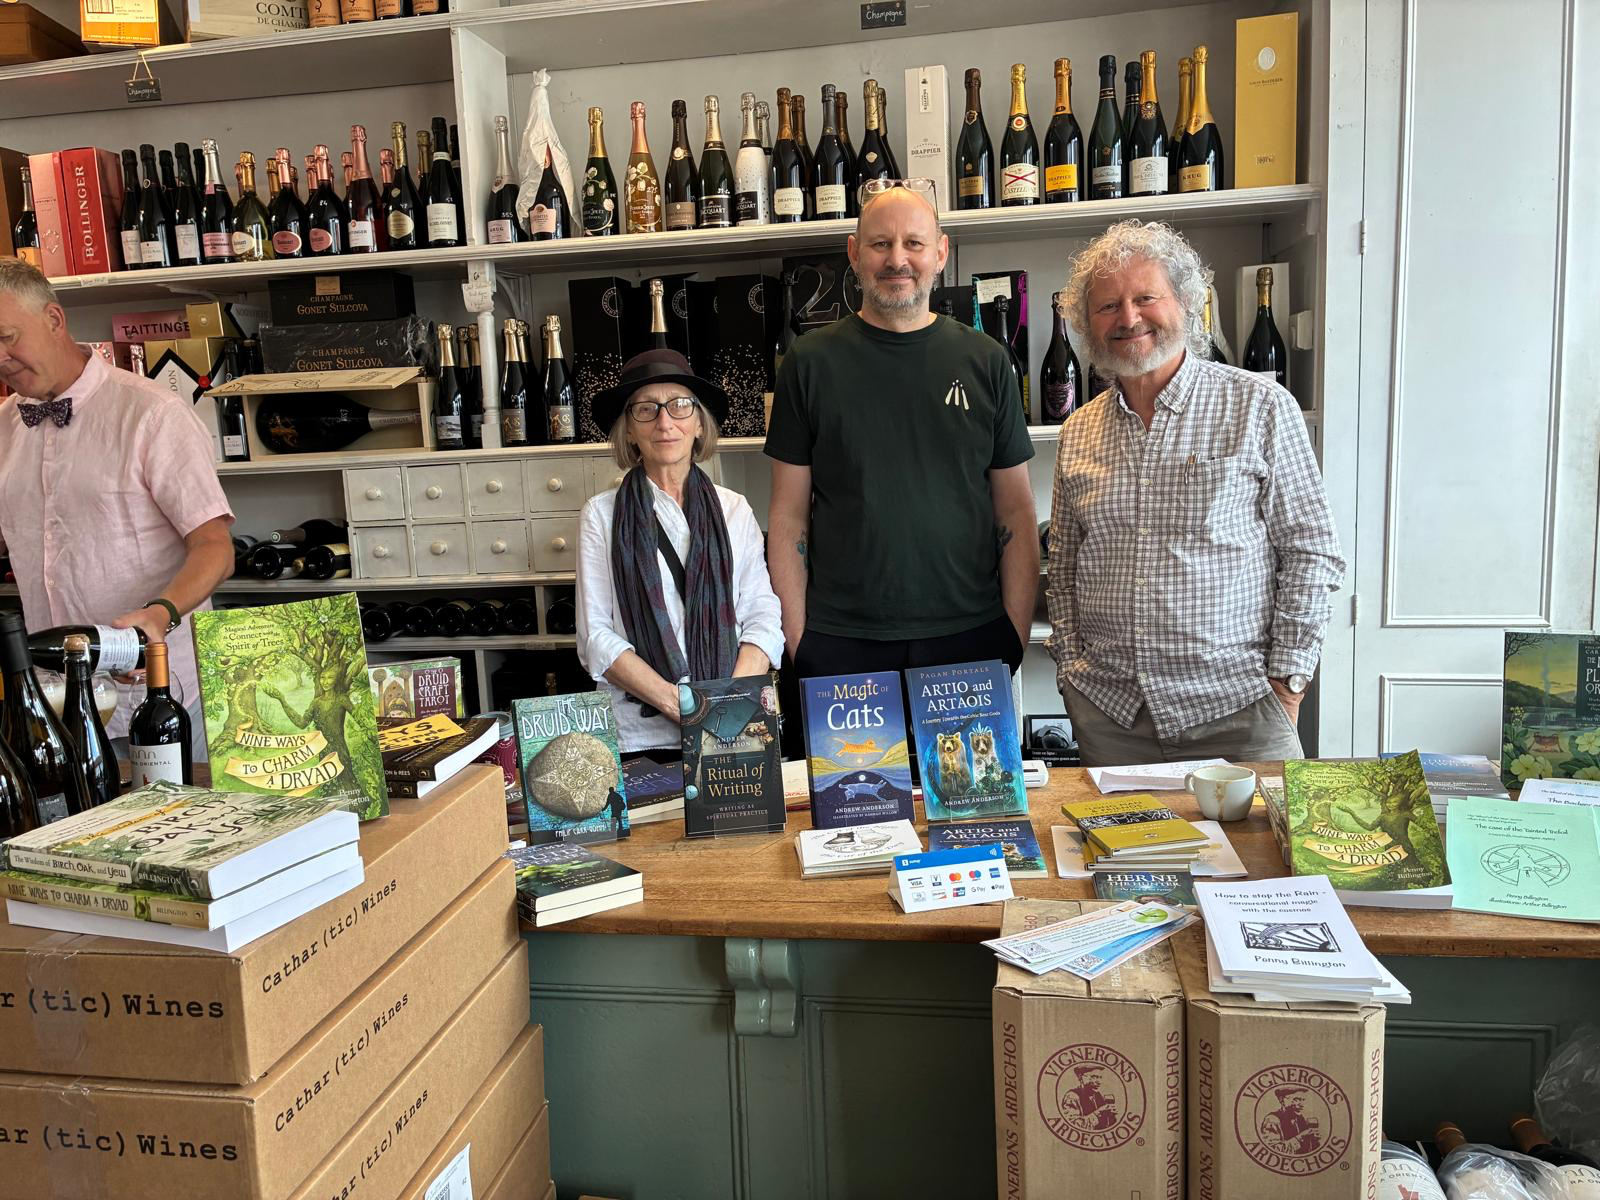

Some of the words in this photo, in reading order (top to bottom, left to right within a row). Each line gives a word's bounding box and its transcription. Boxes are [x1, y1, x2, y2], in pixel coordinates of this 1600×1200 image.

[257, 17, 270, 26] DE
[866, 9, 904, 22] Champagne
[127, 87, 158, 99] Champagne
[911, 147, 941, 156] DRAPPIER
[75, 166, 95, 258] BOLLINGER
[310, 294, 354, 303] CHAMPAGNE
[297, 304, 327, 315] GONET
[329, 303, 369, 313] SULCOVA
[122, 321, 190, 335] TAITTINGE
[312, 346, 365, 357] CHAMPAGNE
[297, 359, 332, 372] GONET
[336, 357, 384, 370] SULCOVA
[229, 632, 262, 641] Connect
[226, 641, 250, 653] Spirit
[252, 642, 259, 651] of
[260, 637, 284, 648] Trees
[920, 671, 948, 679] PAGAN
[951, 666, 990, 676] PORTALS
[418, 673, 449, 687] DRUID
[418, 684, 449, 698] CRAFT
[816, 690, 832, 698] THE
[833, 682, 879, 701] Magic
[921, 681, 968, 698] ARTIO
[972, 680, 993, 692] and
[419, 695, 450, 708] TAROT
[927, 694, 992, 712] ARTAOIS
[521, 712, 571, 740] DRUID
[575, 705, 610, 732] WAY
[827, 703, 884, 731] Cats
[240, 732, 272, 747] NINE
[275, 735, 306, 747] WAYS
[713, 741, 752, 750] ANDERSON
[716, 735, 746, 743] ANDREW
[262, 745, 314, 774] CHARM
[714, 756, 732, 765] THE
[280, 761, 338, 789] DRYAD
[707, 763, 748, 781] Ritual
[751, 761, 765, 779] of
[338, 787, 361, 796] Penny
[708, 781, 763, 797] Writing
[944, 798, 970, 806] ANDREW
[971, 795, 1005, 803] ANDERSON
[706, 812, 738, 820] SPIRITUAL
[739, 809, 769, 817] PRACTICE
[719, 804, 746, 812] WRITING
[835, 806, 861, 814] ANDREW
[862, 803, 895, 811] ANDERSON
[941, 827, 993, 835] ARTIO
[947, 831, 1018, 840] ARTAOIS
[1316, 827, 1345, 838] NINE
[1346, 833, 1373, 841] WAYS
[1334, 840, 1381, 854] CHARM
[1350, 850, 1402, 866] DRYAD
[1106, 873, 1179, 882] HERNE
[1398, 871, 1433, 880] Billington
[1403, 867, 1424, 875] Penny
[138, 872, 182, 885] BILLINGTON
[8, 883, 27, 897] NINE
[28, 886, 48, 899] WAYS
[63, 892, 91, 906] CHARM
[1214, 891, 1236, 899] How
[1239, 891, 1249, 899] to
[1252, 891, 1273, 900] stop
[1276, 891, 1292, 899] the
[1294, 889, 1319, 898] Rain
[262, 938, 318, 994] Cathar
[322, 906, 358, 948] (tic)
[360, 877, 398, 915] Wines
[1254, 955, 1289, 965] Penny
[1291, 957, 1346, 969] Billington
[29, 988, 111, 1018] (tic)
[122, 993, 225, 1018] Wines
[274, 1069, 331, 1133] Cathar
[335, 1028, 370, 1076] (tic)
[372, 992, 409, 1035] Wines
[1044, 1047, 1138, 1084] VIGNERONS
[1003, 1021, 1019, 1125] ARDECHOIS
[1166, 1030, 1180, 1133] ARDECHOIS
[1242, 1068, 1344, 1106] VIGNERONS
[1199, 1038, 1214, 1148] ARDECHOIS
[1369, 1048, 1381, 1152] ARDECHOIS
[360, 1130, 393, 1180] (tic)
[395, 1088, 429, 1136] Wines
[1047, 1111, 1141, 1149] ARDECHOIS
[43, 1125, 125, 1157] (tic)
[137, 1134, 238, 1161] Wines
[1245, 1135, 1346, 1173] ARDECHOIS
